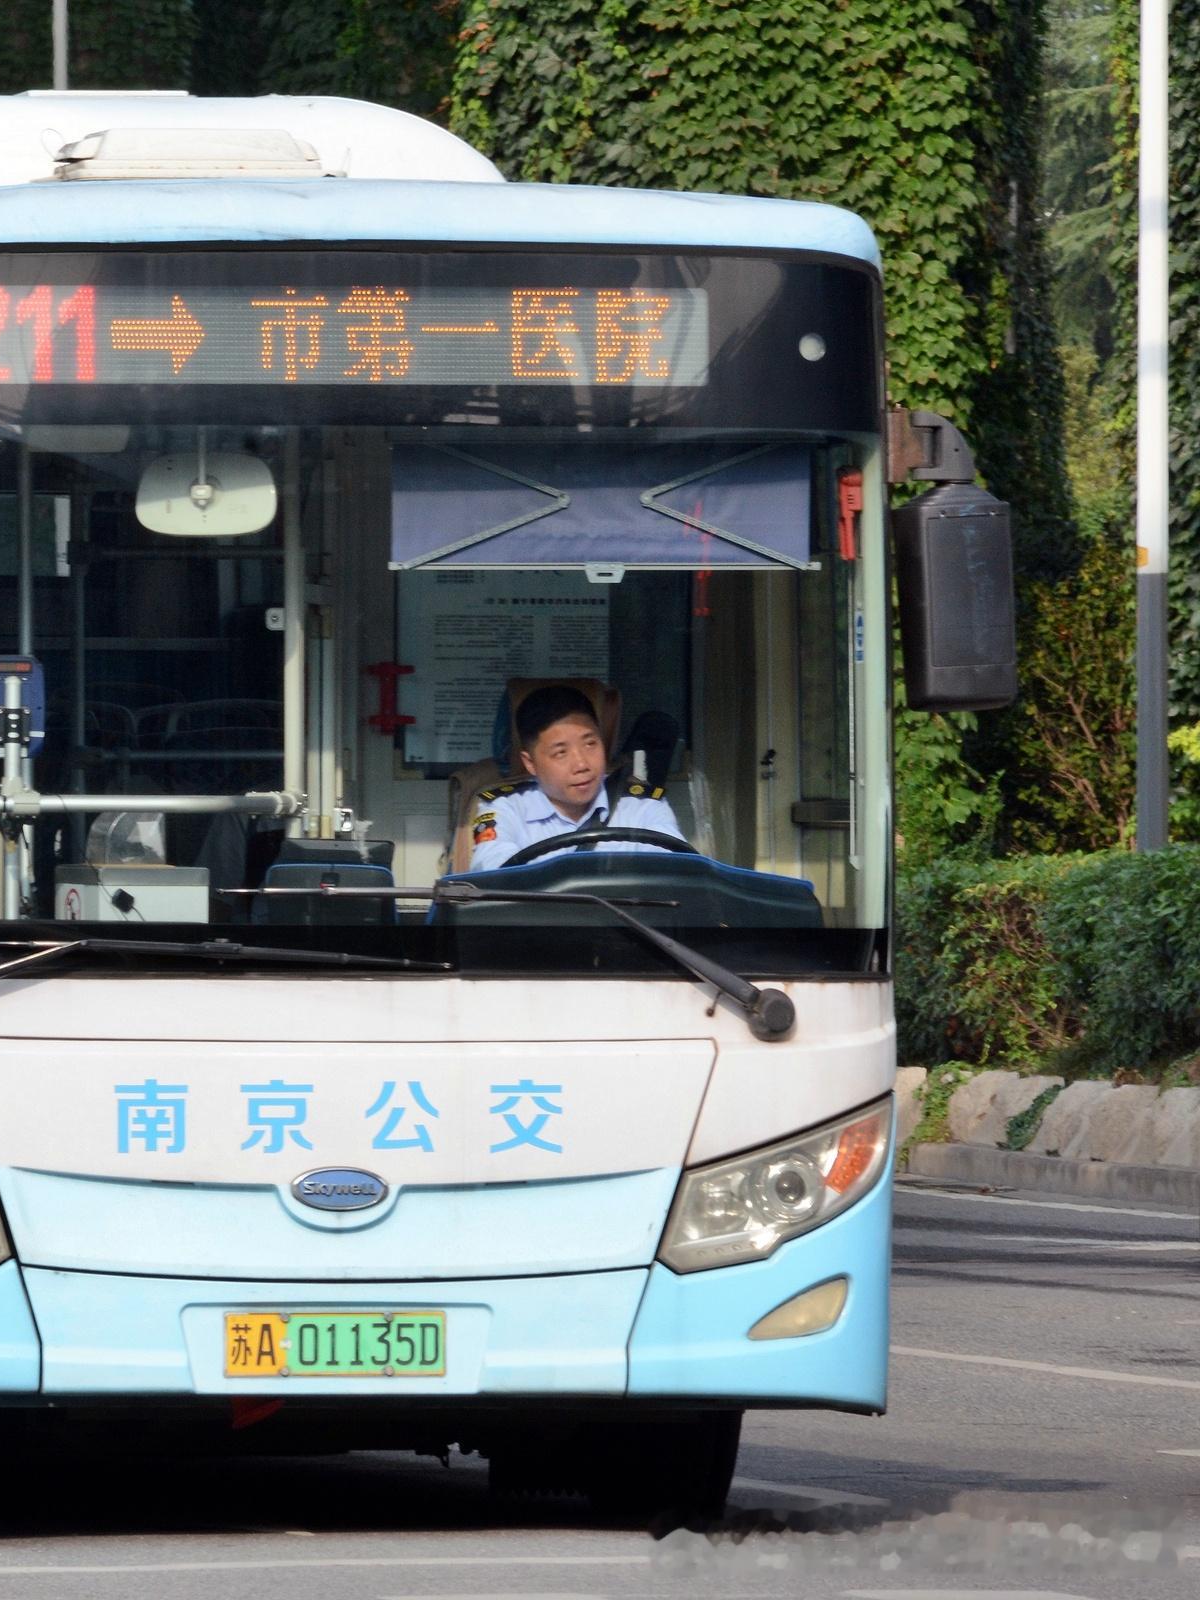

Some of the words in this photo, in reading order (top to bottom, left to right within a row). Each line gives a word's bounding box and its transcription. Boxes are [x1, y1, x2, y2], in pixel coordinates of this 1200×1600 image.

[251, 286, 670, 383] 市第一医院
[113, 1078, 564, 1155] 南京公交
[302, 1180, 378, 1198] Skywell
